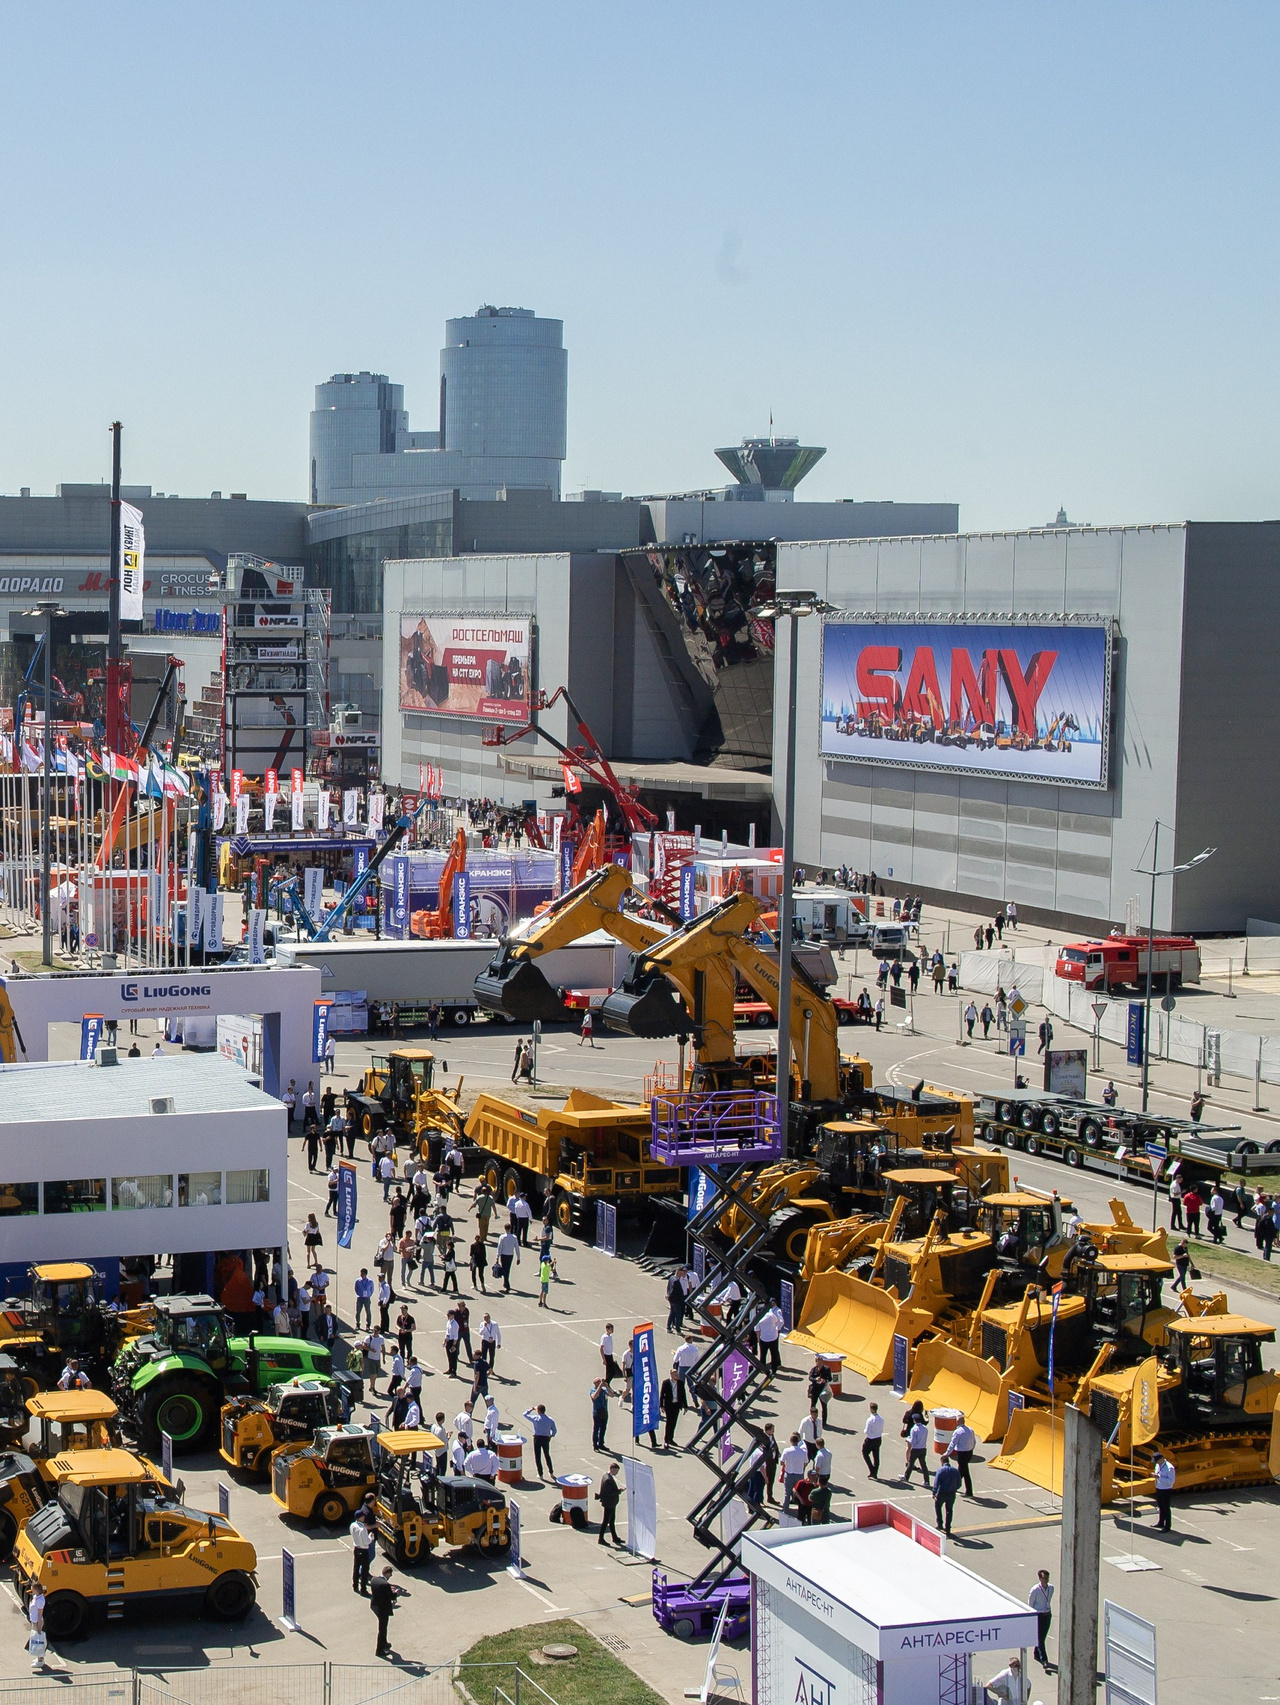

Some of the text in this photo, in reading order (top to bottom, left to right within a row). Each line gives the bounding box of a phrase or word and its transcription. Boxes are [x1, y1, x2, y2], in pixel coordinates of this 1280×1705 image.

[160, 574, 211, 584] CROCUS
[269, 616, 299, 626] NFLG
[452, 628, 523, 643] РОСТСЕЛЬМАШ
[452, 654, 477, 665] ПРЕМЬЕРА
[856, 646, 1059, 735] SANY
[345, 735, 377, 745] NFLG
[469, 869, 512, 877] КРАНЭКС
[684, 872, 692, 917] КРАНЭКС
[753, 962, 780, 991] LiuGo
[143, 985, 211, 998] LiuGong
[87, 1031, 95, 1060] LiuGo
[704, 1151, 740, 1159] АНТАРЕС-НТ
[697, 1168, 705, 1211] iuGong
[31, 1486, 44, 1509] LiuGon
[786, 1576, 835, 1619] АНТАРЕС-НТ
[900, 1627, 1002, 1650] АНТАРЕС-НТ
